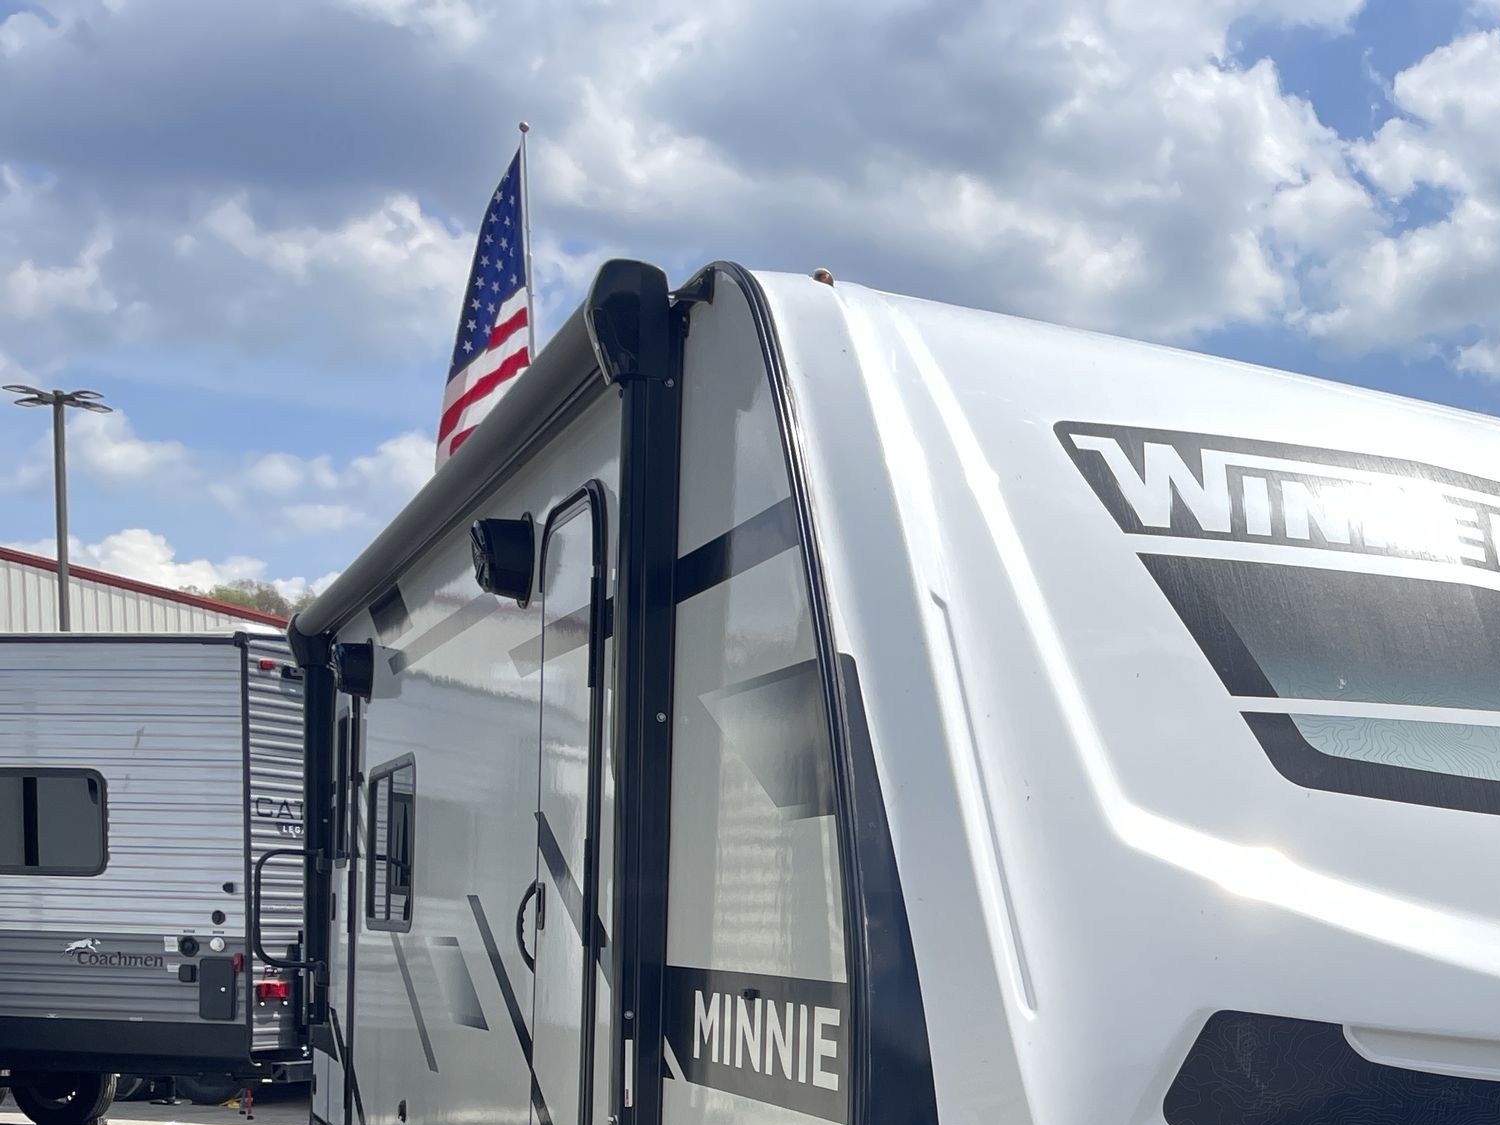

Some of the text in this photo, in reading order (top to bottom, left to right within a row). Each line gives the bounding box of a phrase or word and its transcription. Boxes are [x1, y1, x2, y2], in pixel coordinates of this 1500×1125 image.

[282, 825, 304, 835] LEG
[77, 951, 163, 967] Coachmen
[693, 990, 841, 1091] MINNIE
